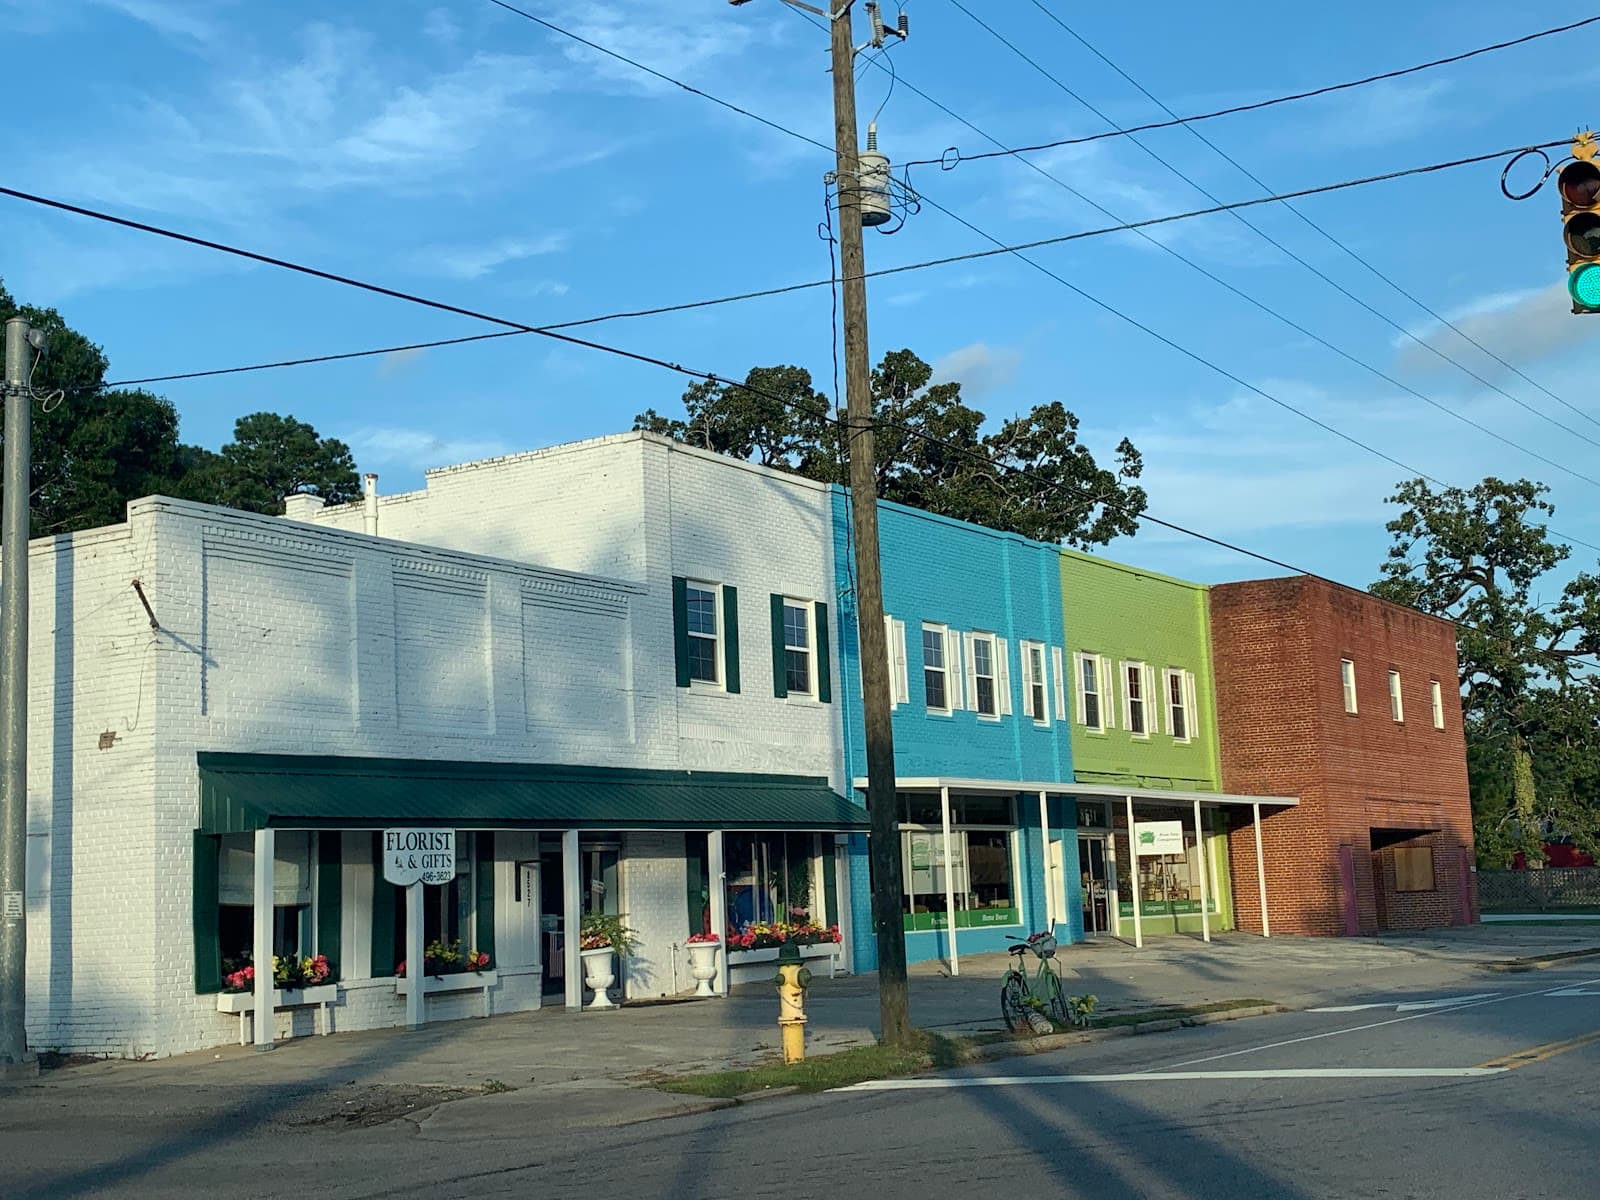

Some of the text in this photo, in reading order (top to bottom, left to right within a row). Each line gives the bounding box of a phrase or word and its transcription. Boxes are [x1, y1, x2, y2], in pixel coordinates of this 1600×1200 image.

[386, 832, 452, 851] FLORIST
[408, 854, 452, 869] & GIFTS
